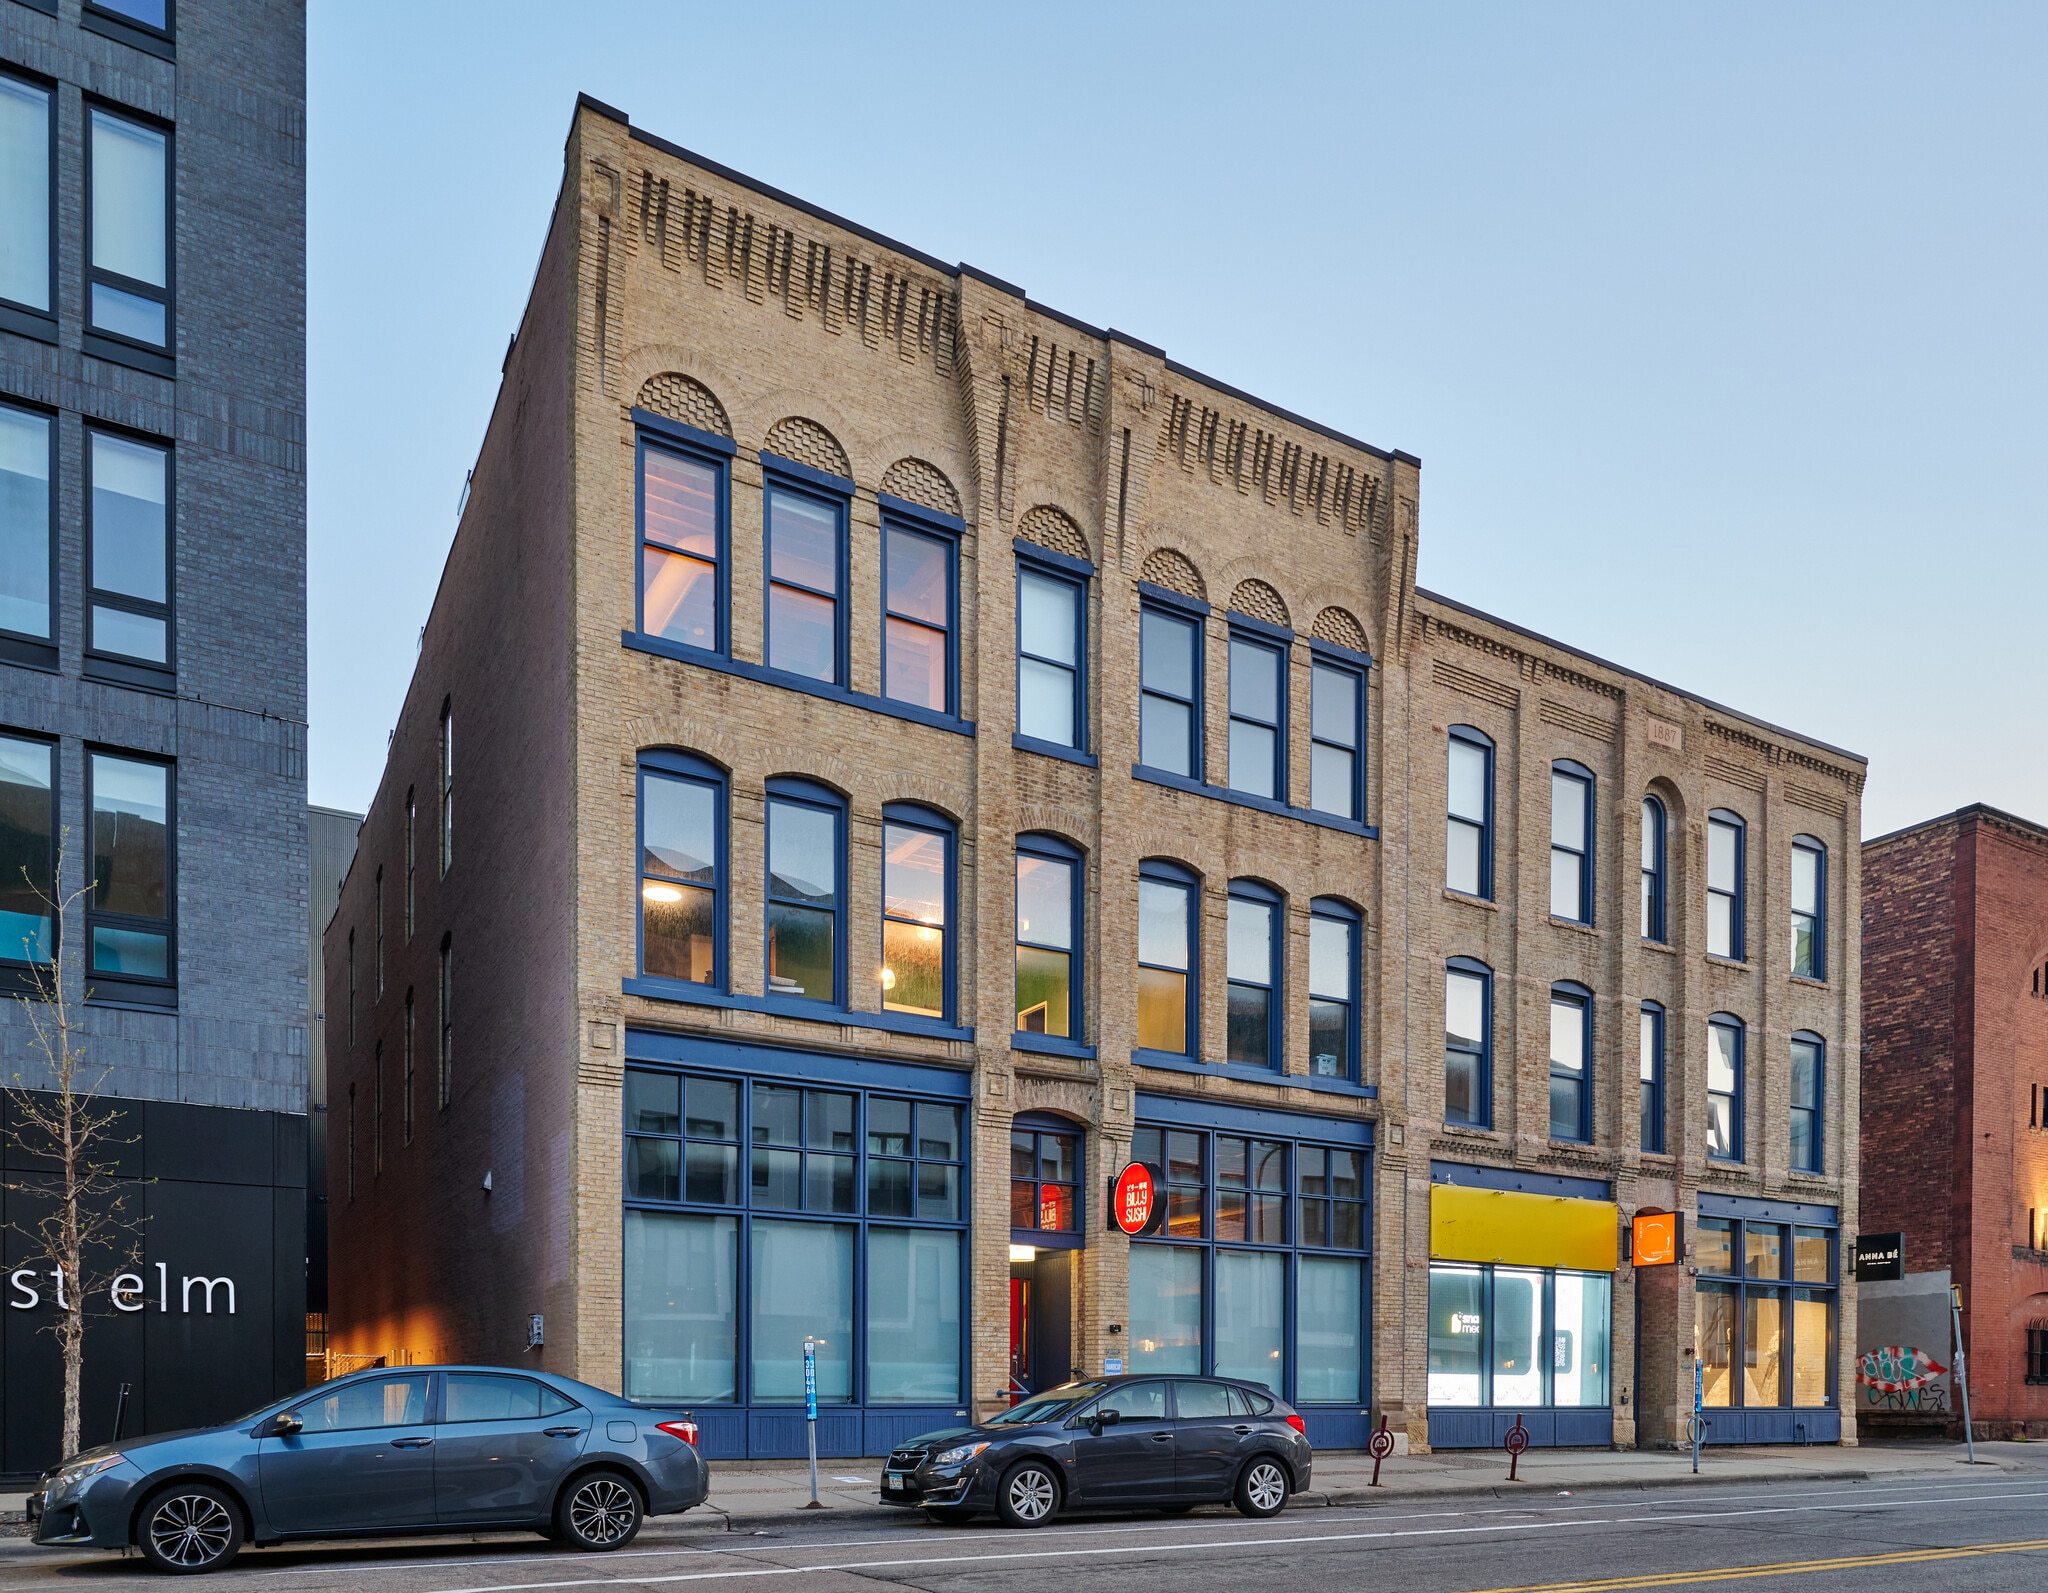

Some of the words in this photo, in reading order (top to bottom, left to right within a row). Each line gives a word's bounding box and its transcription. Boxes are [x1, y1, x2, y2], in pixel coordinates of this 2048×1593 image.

[1653, 724, 1677, 743] 1887
[1126, 1190, 1147, 1207] BILLY
[1125, 1206, 1147, 1223] SUSHI
[1858, 1252, 1885, 1261] ANNA
[1886, 1248, 1899, 1259] BÉ
[10, 1263, 69, 1309] st
[111, 1262, 236, 1314] elm
